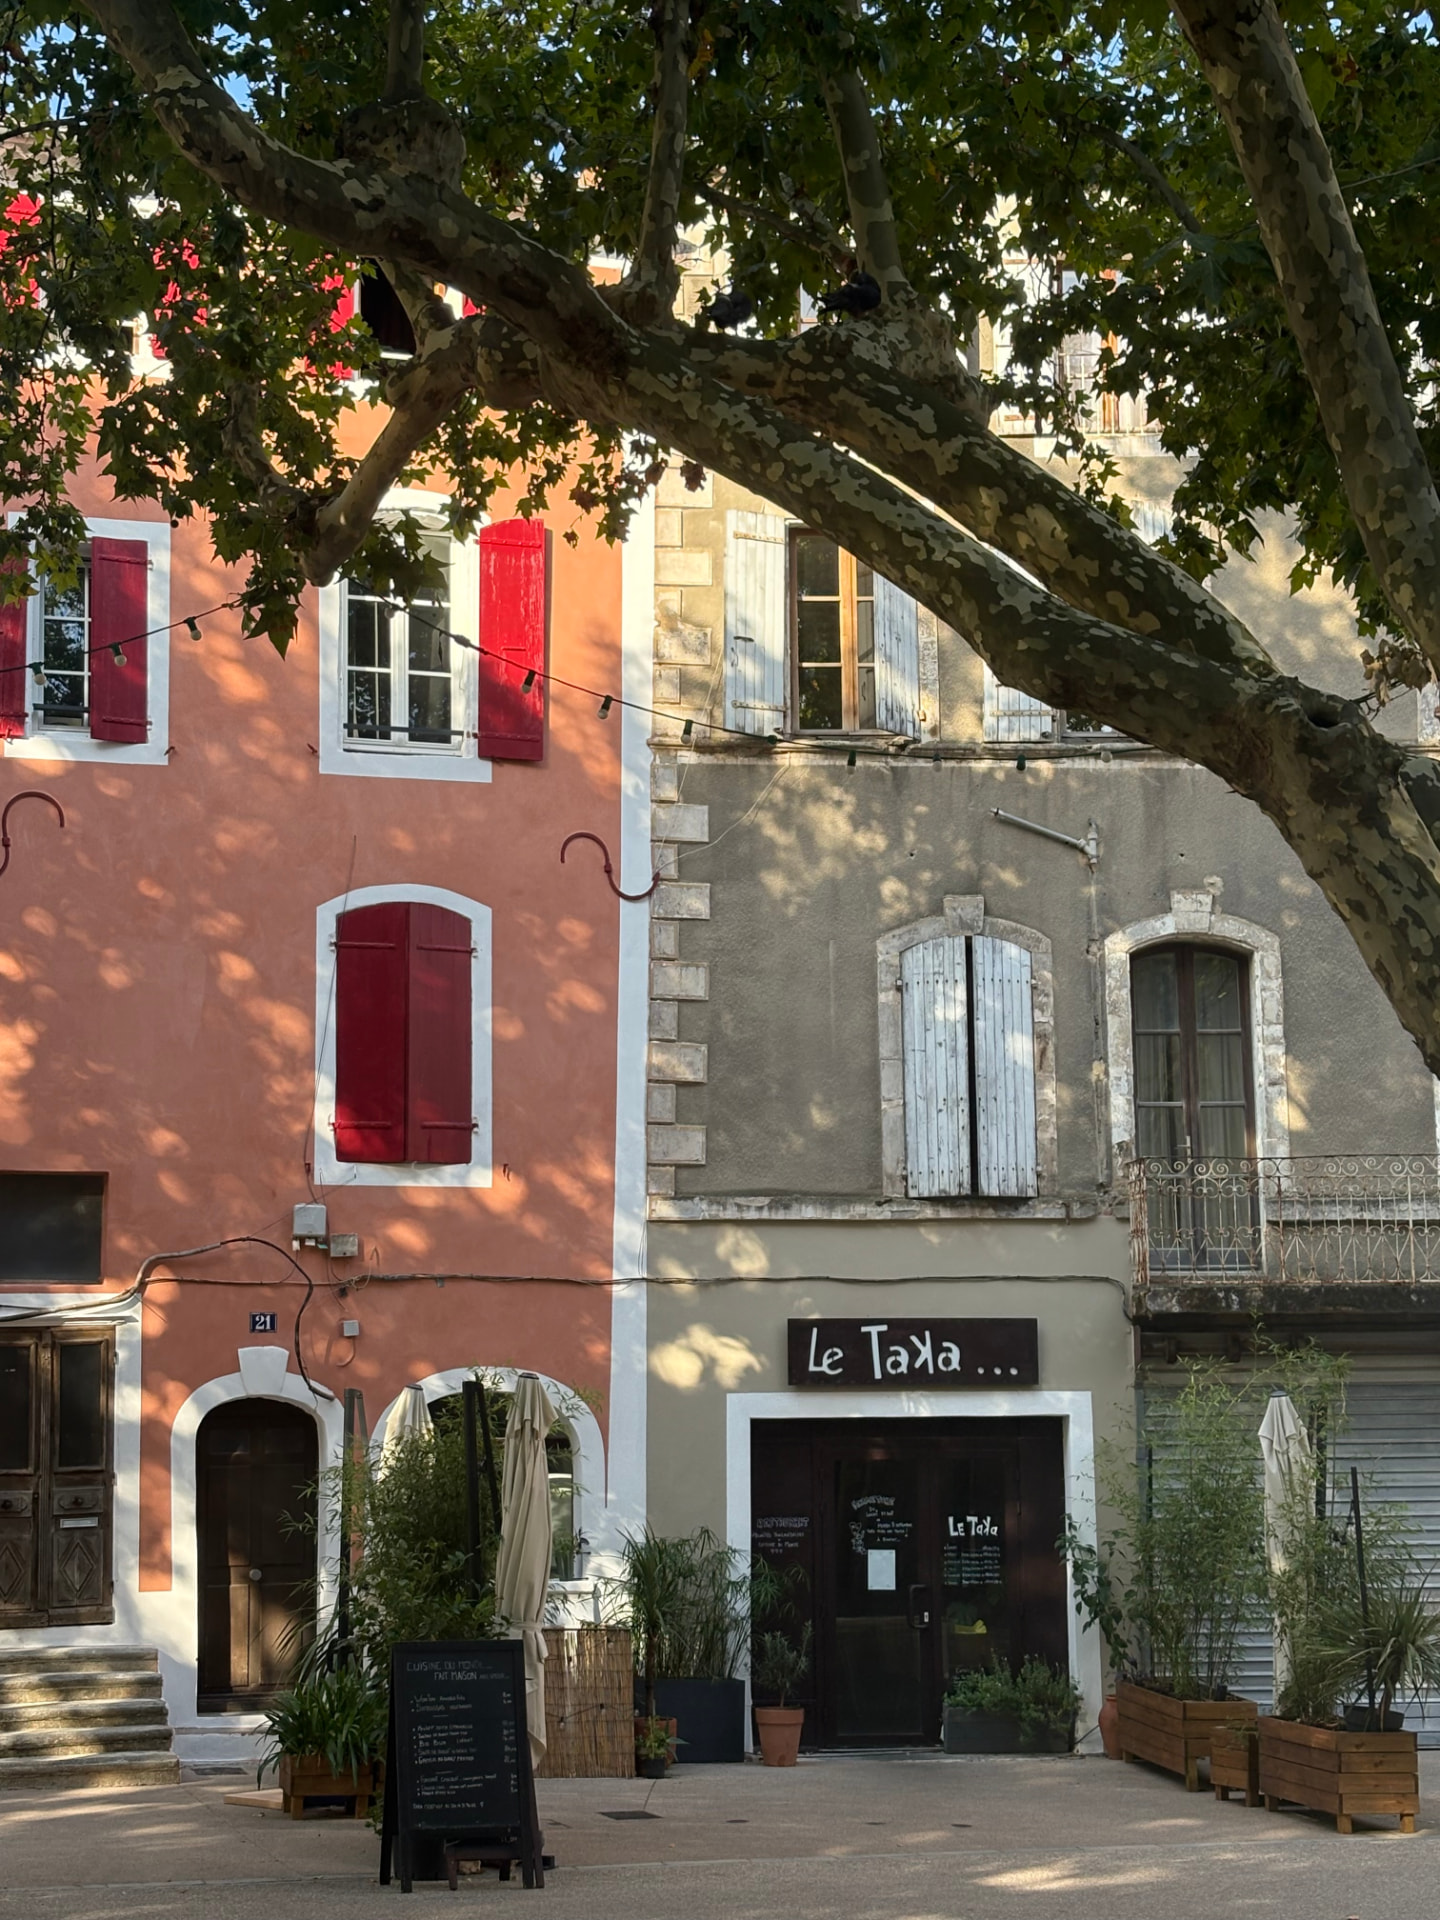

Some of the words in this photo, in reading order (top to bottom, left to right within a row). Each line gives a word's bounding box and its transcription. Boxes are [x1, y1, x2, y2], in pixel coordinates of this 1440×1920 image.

[255, 1314, 271, 1330] 21
[808, 1327, 844, 1375] Le
[450, 1670, 477, 1680] MAISON
